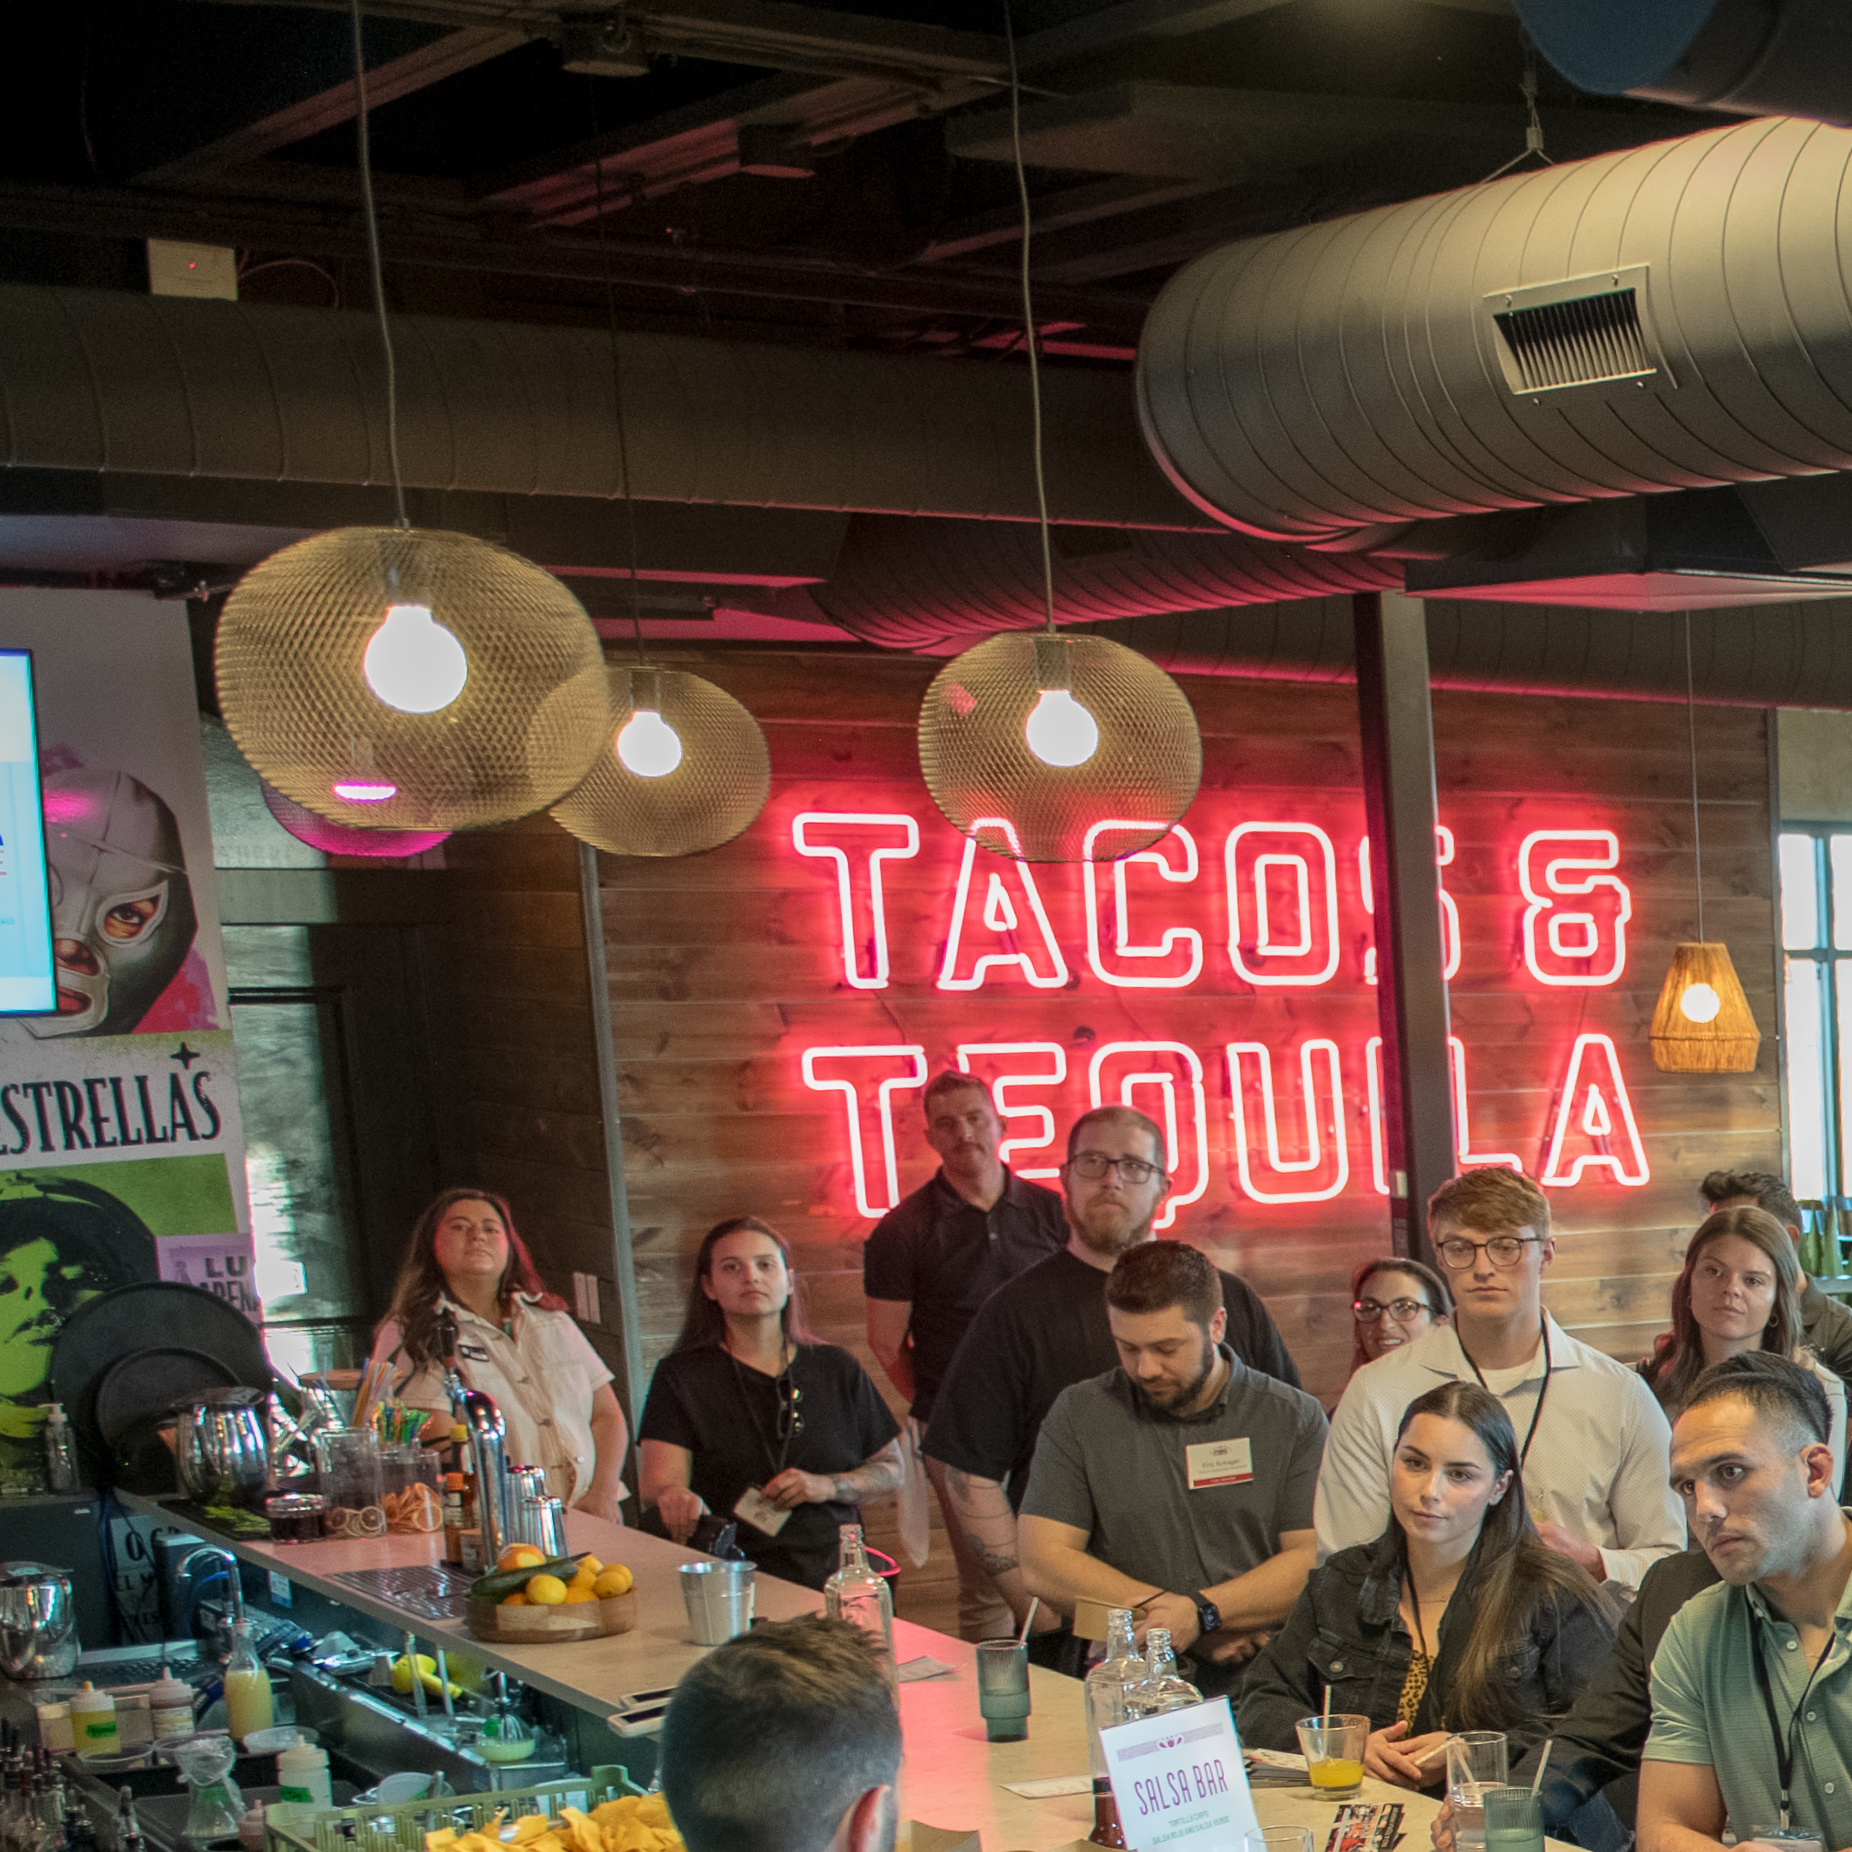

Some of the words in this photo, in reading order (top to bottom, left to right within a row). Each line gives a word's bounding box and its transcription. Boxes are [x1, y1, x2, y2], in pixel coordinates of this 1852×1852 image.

[791, 811, 1463, 990] TACO
[1516, 827, 1633, 988] &
[0, 1071, 222, 1157] STRELLAS
[1134, 1769, 1193, 1816] SALSA
[1192, 1759, 1229, 1799] BAR
